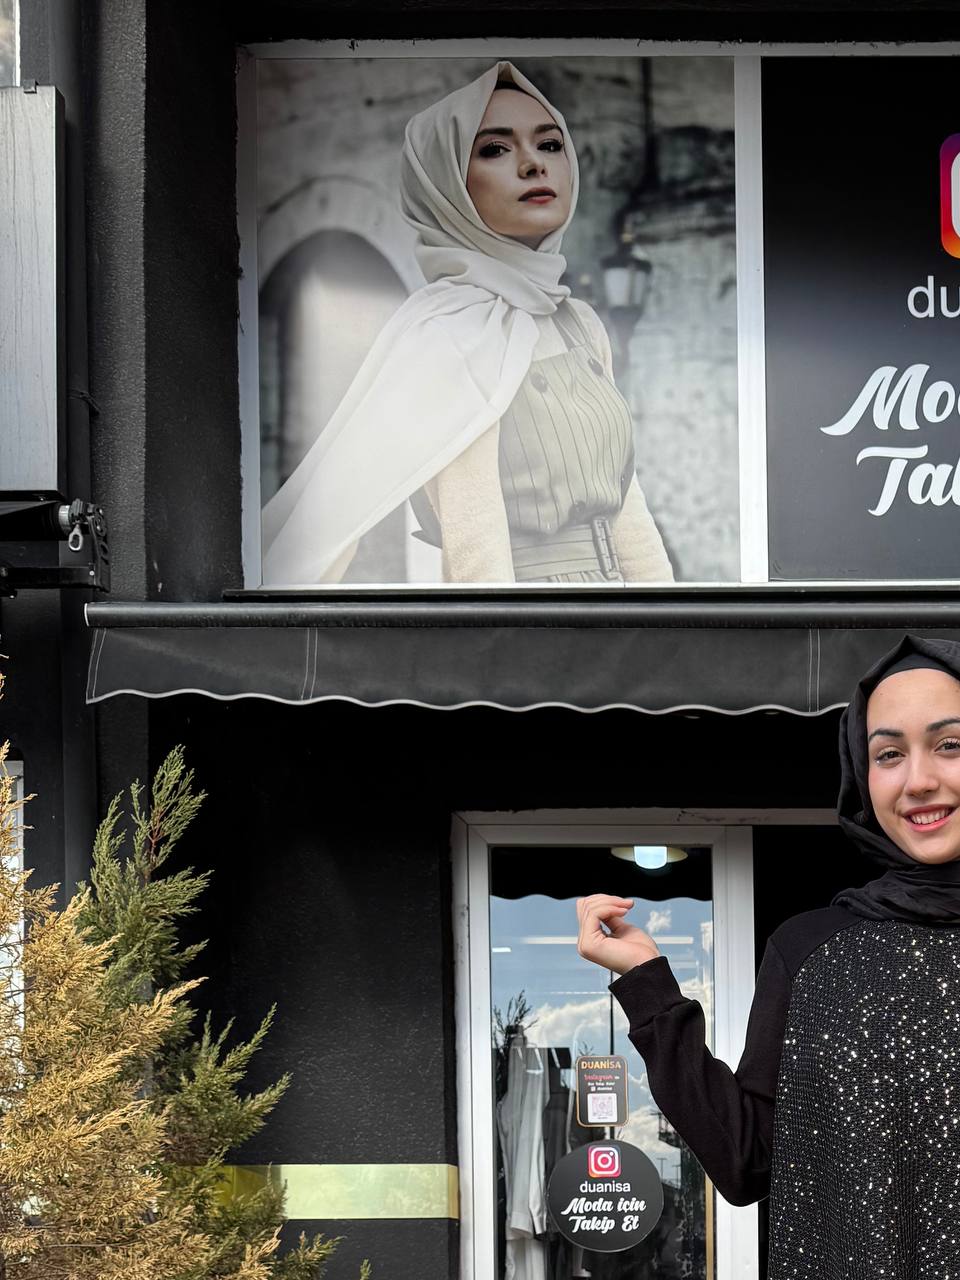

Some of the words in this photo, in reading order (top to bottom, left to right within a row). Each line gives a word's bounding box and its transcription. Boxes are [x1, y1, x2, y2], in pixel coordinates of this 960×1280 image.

[579, 1180, 631, 1193] duanisa
[560, 1197, 614, 1215] Moda
[617, 1197, 647, 1213] için
[568, 1215, 616, 1234] Takip
[621, 1215, 640, 1232] Et
